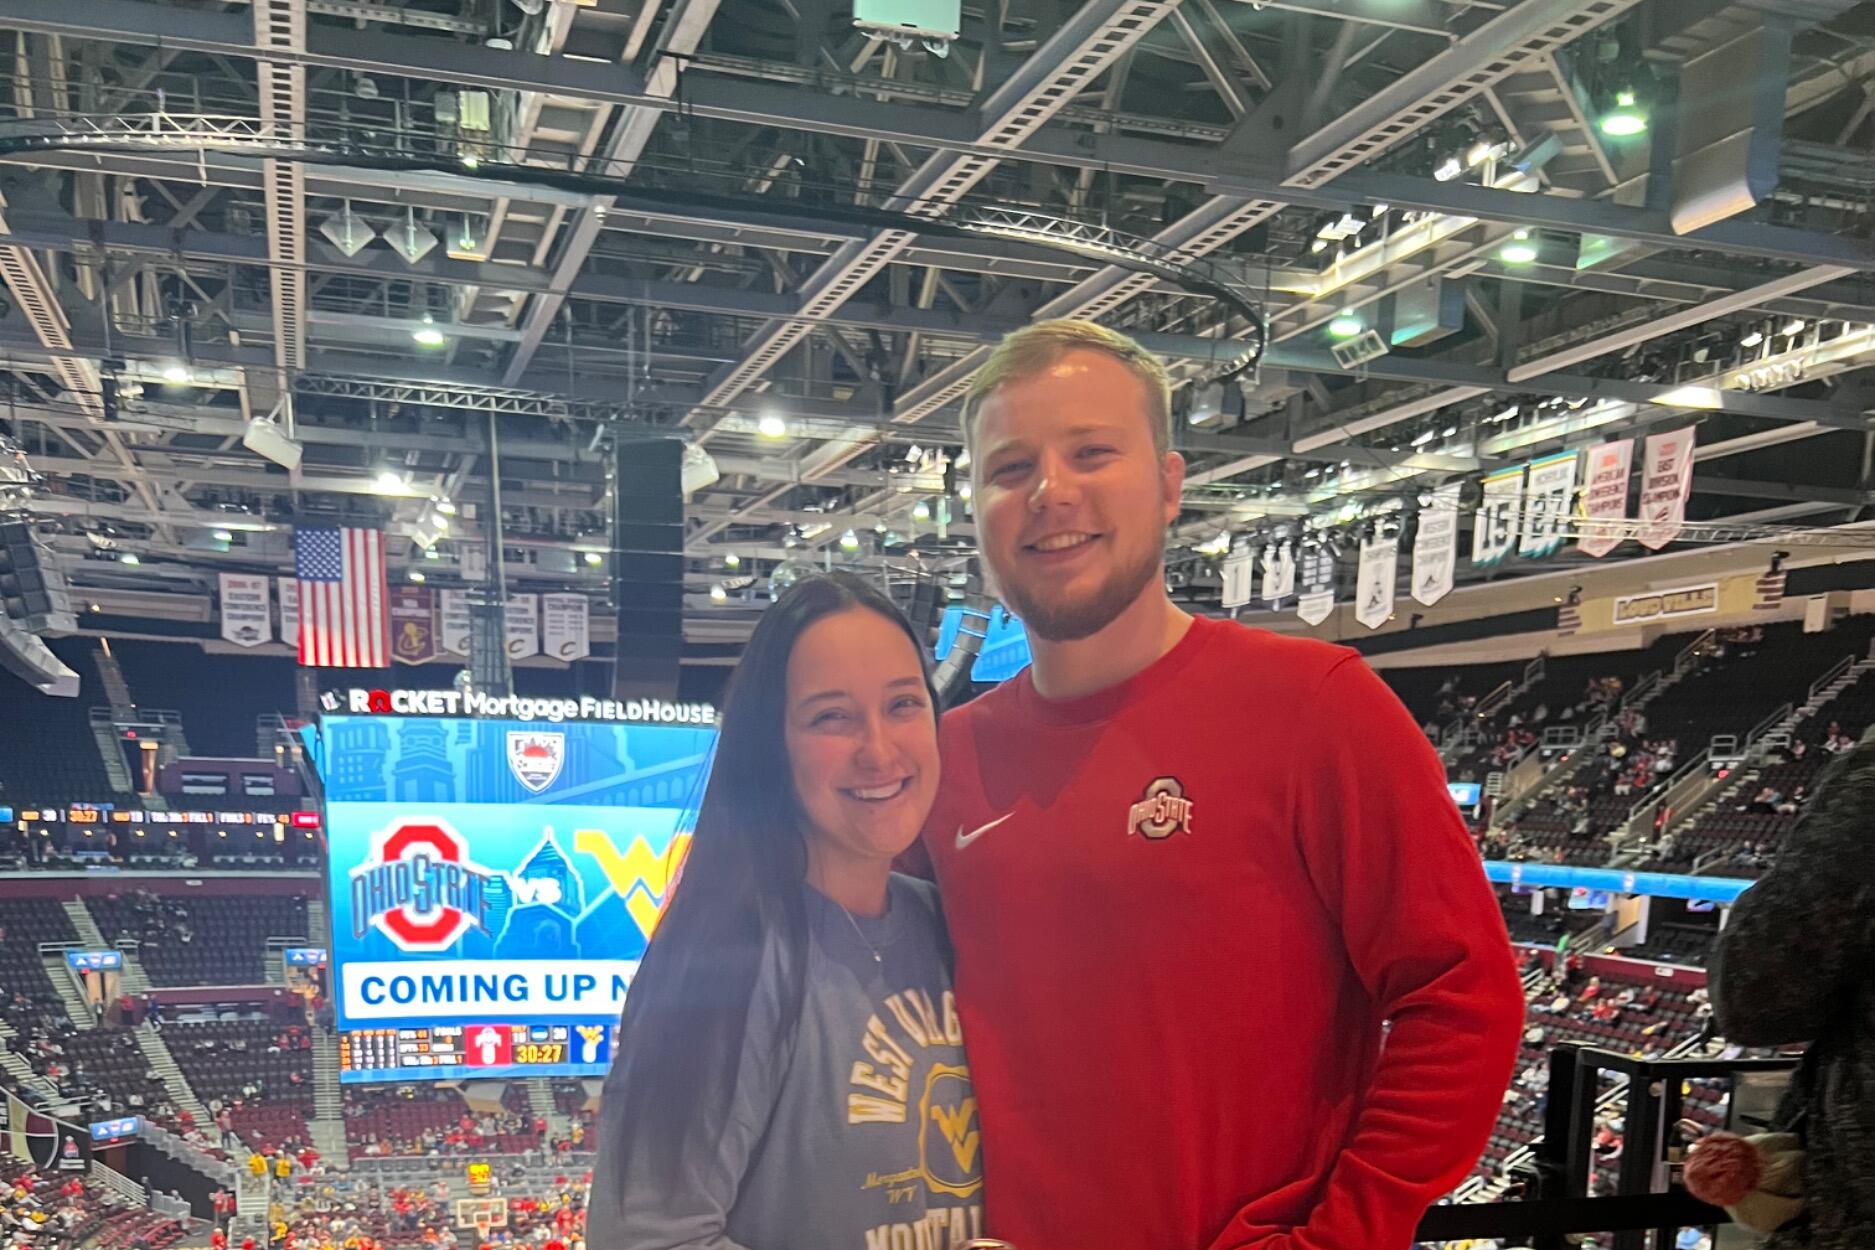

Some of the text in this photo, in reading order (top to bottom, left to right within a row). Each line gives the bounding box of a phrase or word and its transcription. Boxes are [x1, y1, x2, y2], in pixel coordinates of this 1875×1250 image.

[350, 690, 715, 724] ROCKET Mortgage FIELDHOUSE
[361, 974, 529, 1005] COMING
[545, 974, 597, 1001] UP
[516, 1044, 563, 1064] 30:27
